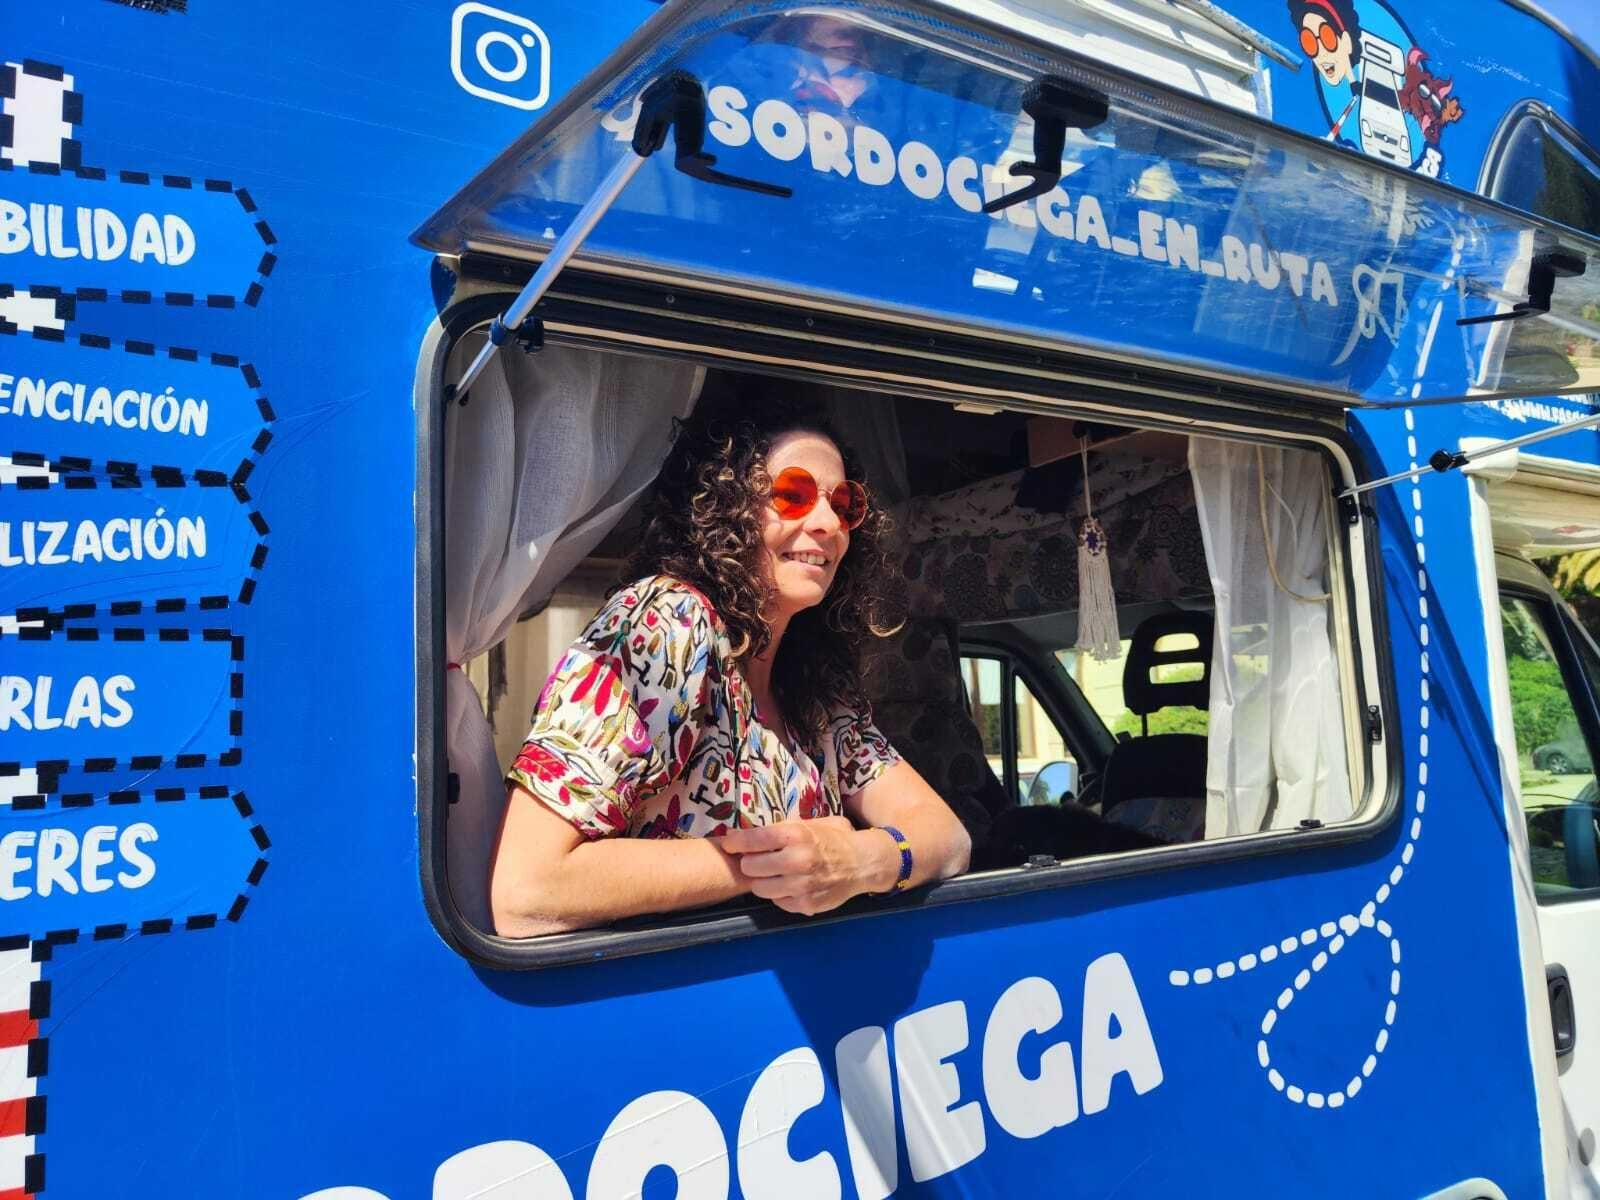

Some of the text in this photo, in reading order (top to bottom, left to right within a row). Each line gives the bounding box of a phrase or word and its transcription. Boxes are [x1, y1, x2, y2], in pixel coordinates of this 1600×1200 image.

[0, 200, 195, 265] BILIDAD
[0, 507, 206, 566] LIZACIÓN
[0, 676, 134, 730] RLAS
[0, 823, 157, 900] ERES
[292, 952, 1164, 1200] OCIEGA
